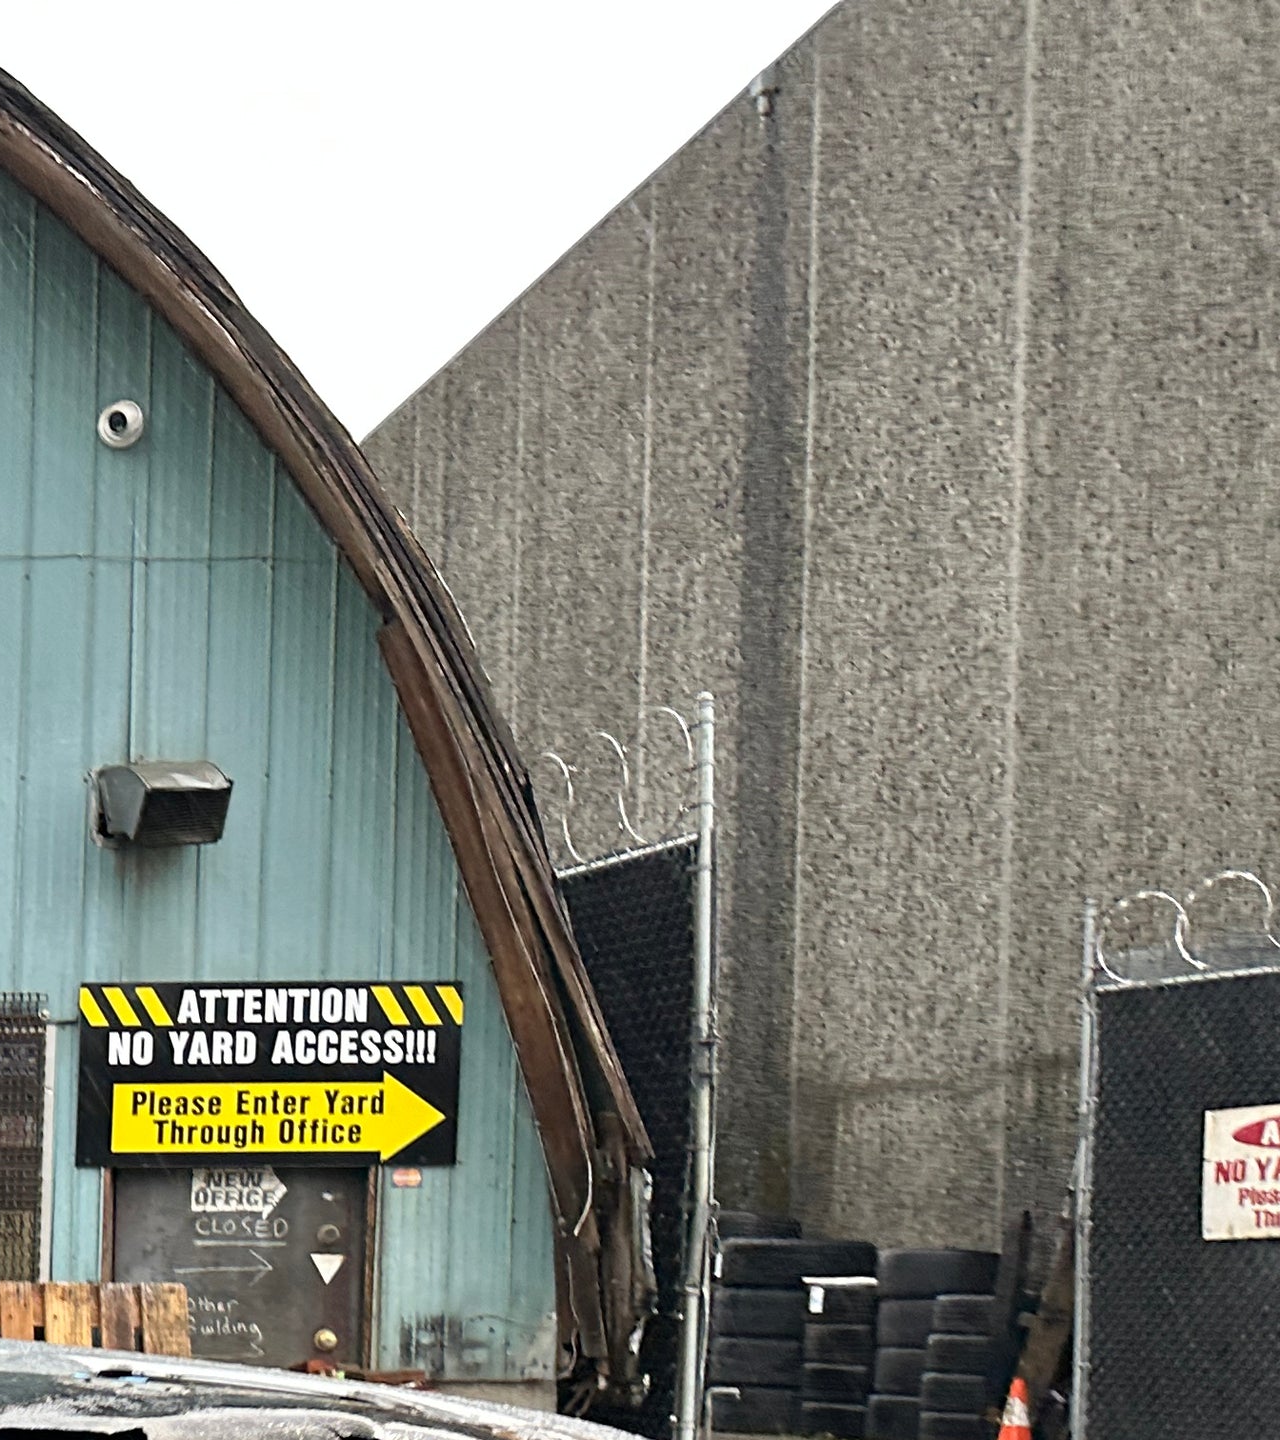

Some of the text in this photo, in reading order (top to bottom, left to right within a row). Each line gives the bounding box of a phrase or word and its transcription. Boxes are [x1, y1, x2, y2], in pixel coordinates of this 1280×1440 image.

[176, 988, 369, 1025] ATTENTION
[107, 1029, 437, 1067] NO YARD ACCESS!!!
[131, 1088, 385, 1116] Please Enter Yard
[153, 1118, 362, 1149] Through Office
[206, 1168, 261, 1188] NEW
[1215, 1159, 1246, 1184] NO
[195, 1216, 289, 1239] CLOSED
